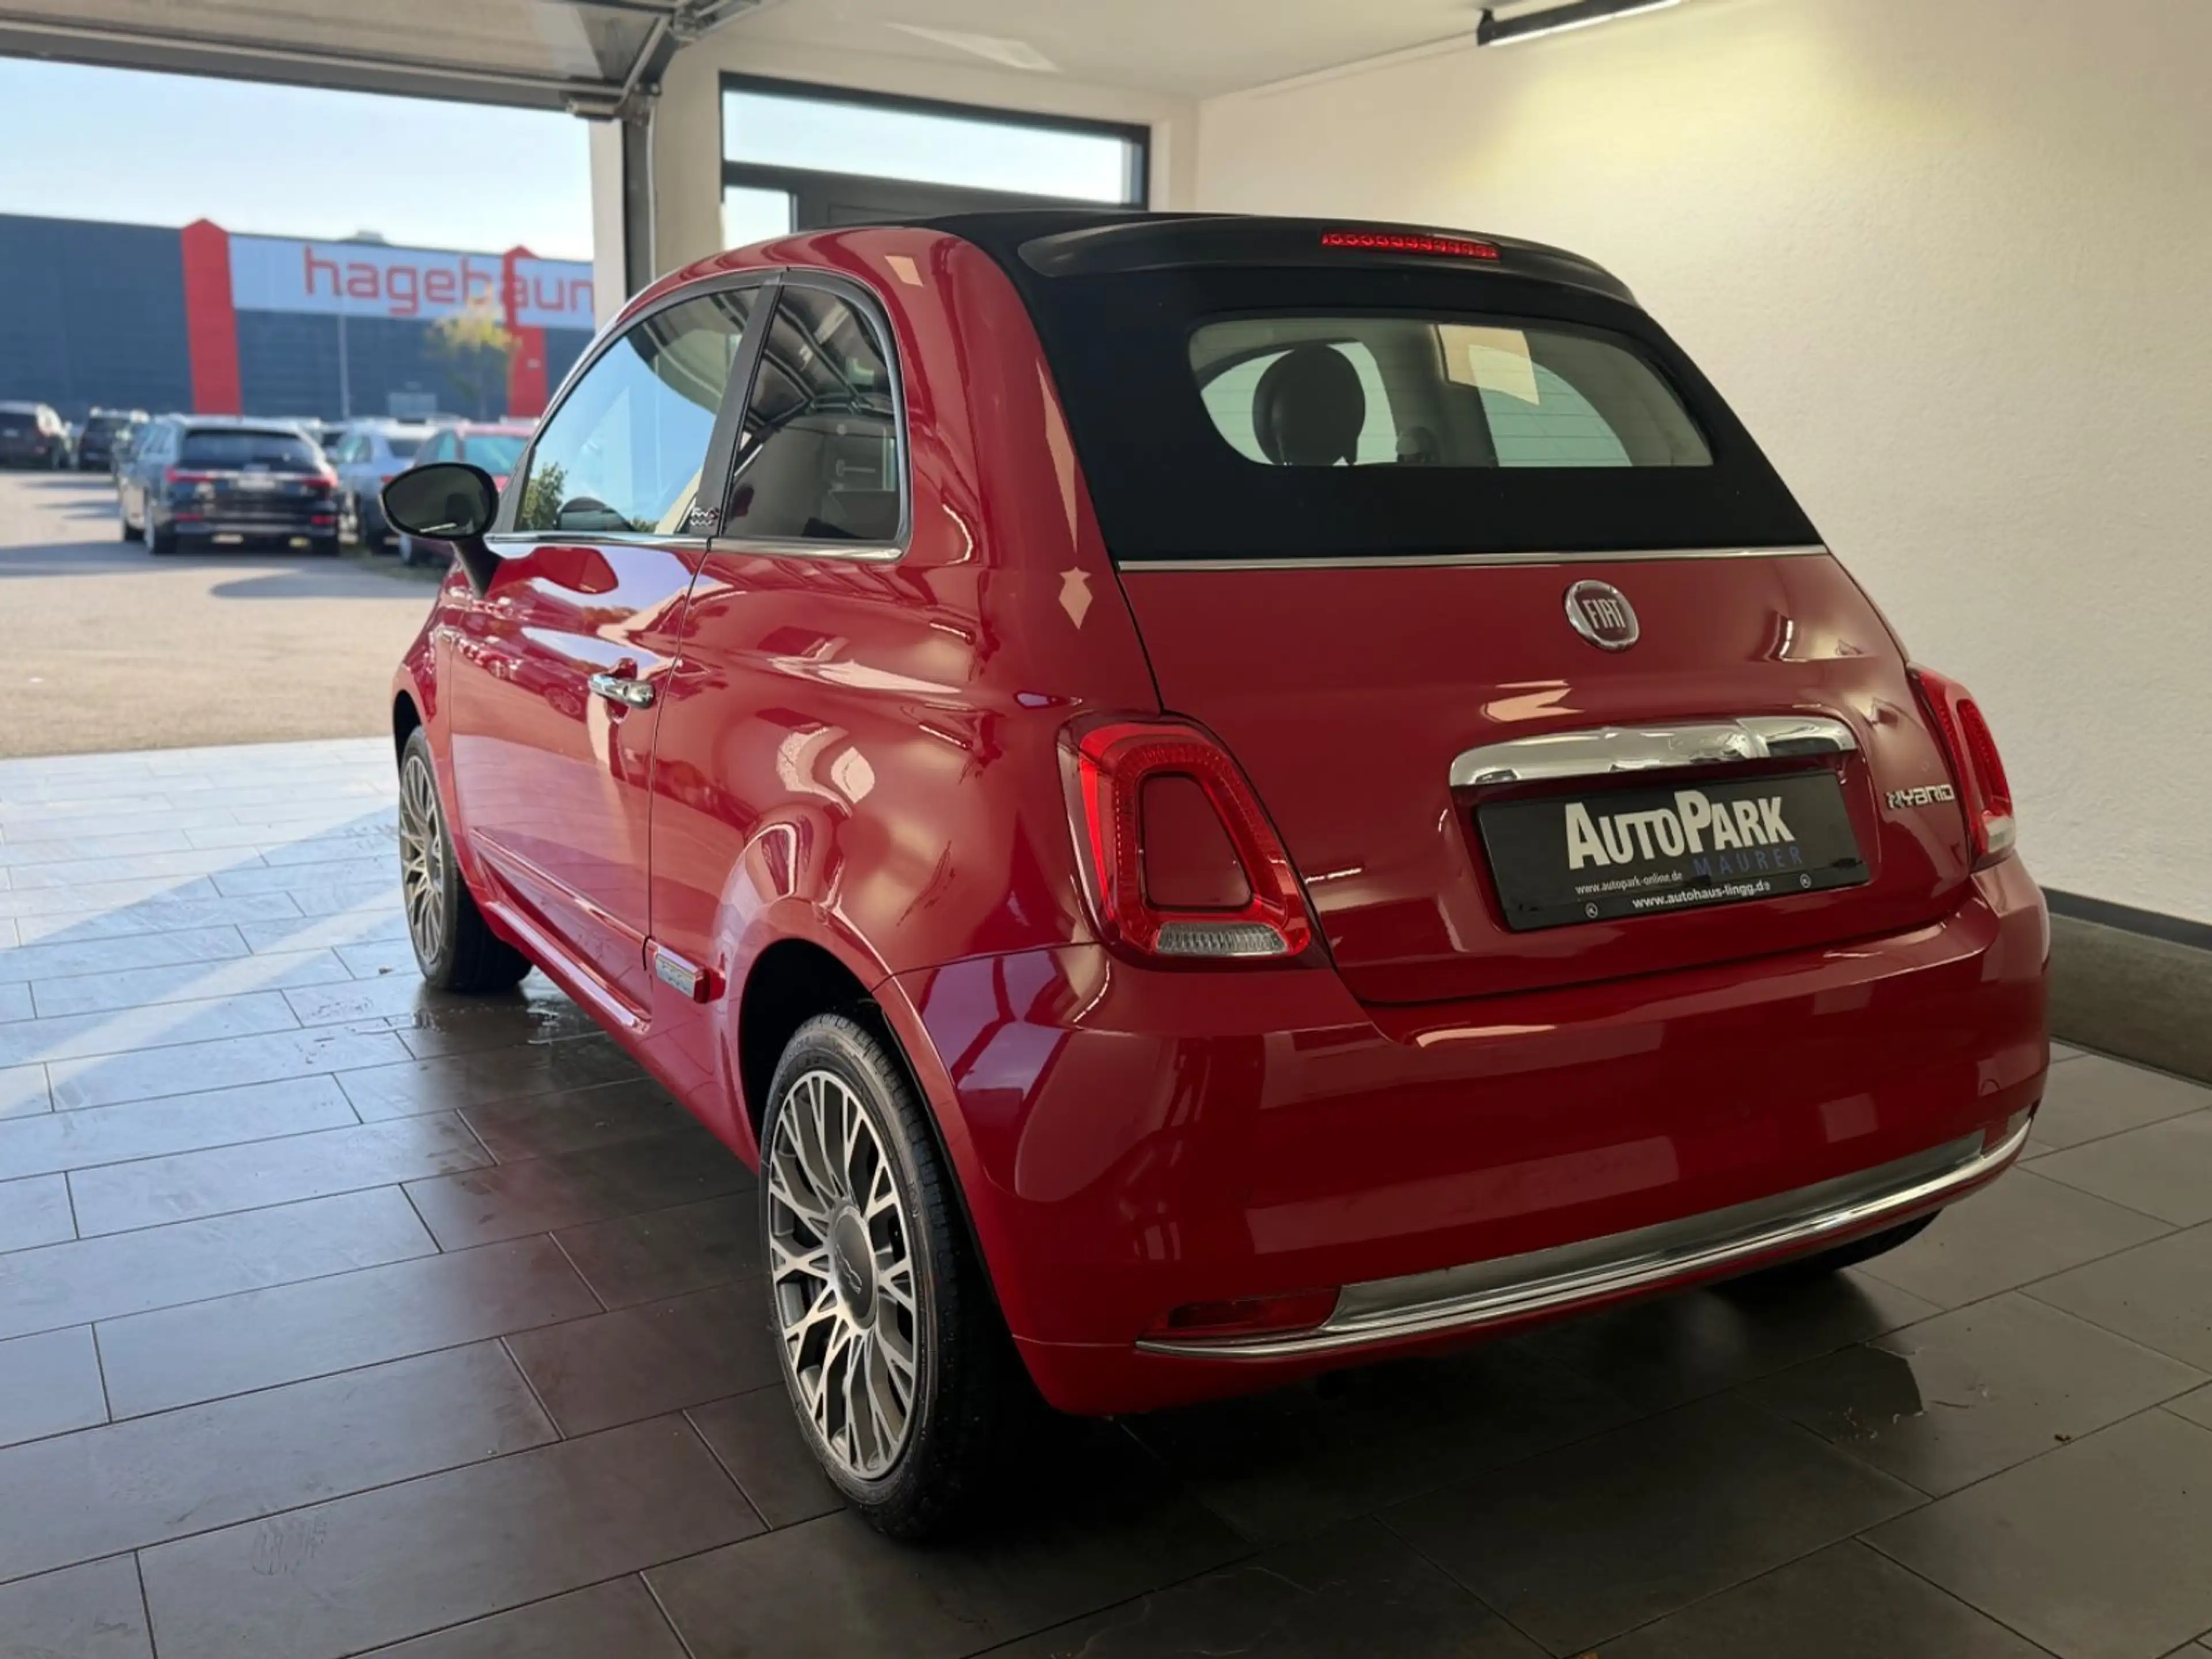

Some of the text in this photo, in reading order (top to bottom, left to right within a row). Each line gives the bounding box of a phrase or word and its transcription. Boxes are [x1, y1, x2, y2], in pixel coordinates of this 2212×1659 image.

[1582, 598, 1626, 630] FIAT
[1692, 846, 1803, 877] MAURER
[1574, 870, 1683, 895] www.autopark-online.de
[1632, 879, 1771, 908] www.autohaus-lingg.de
